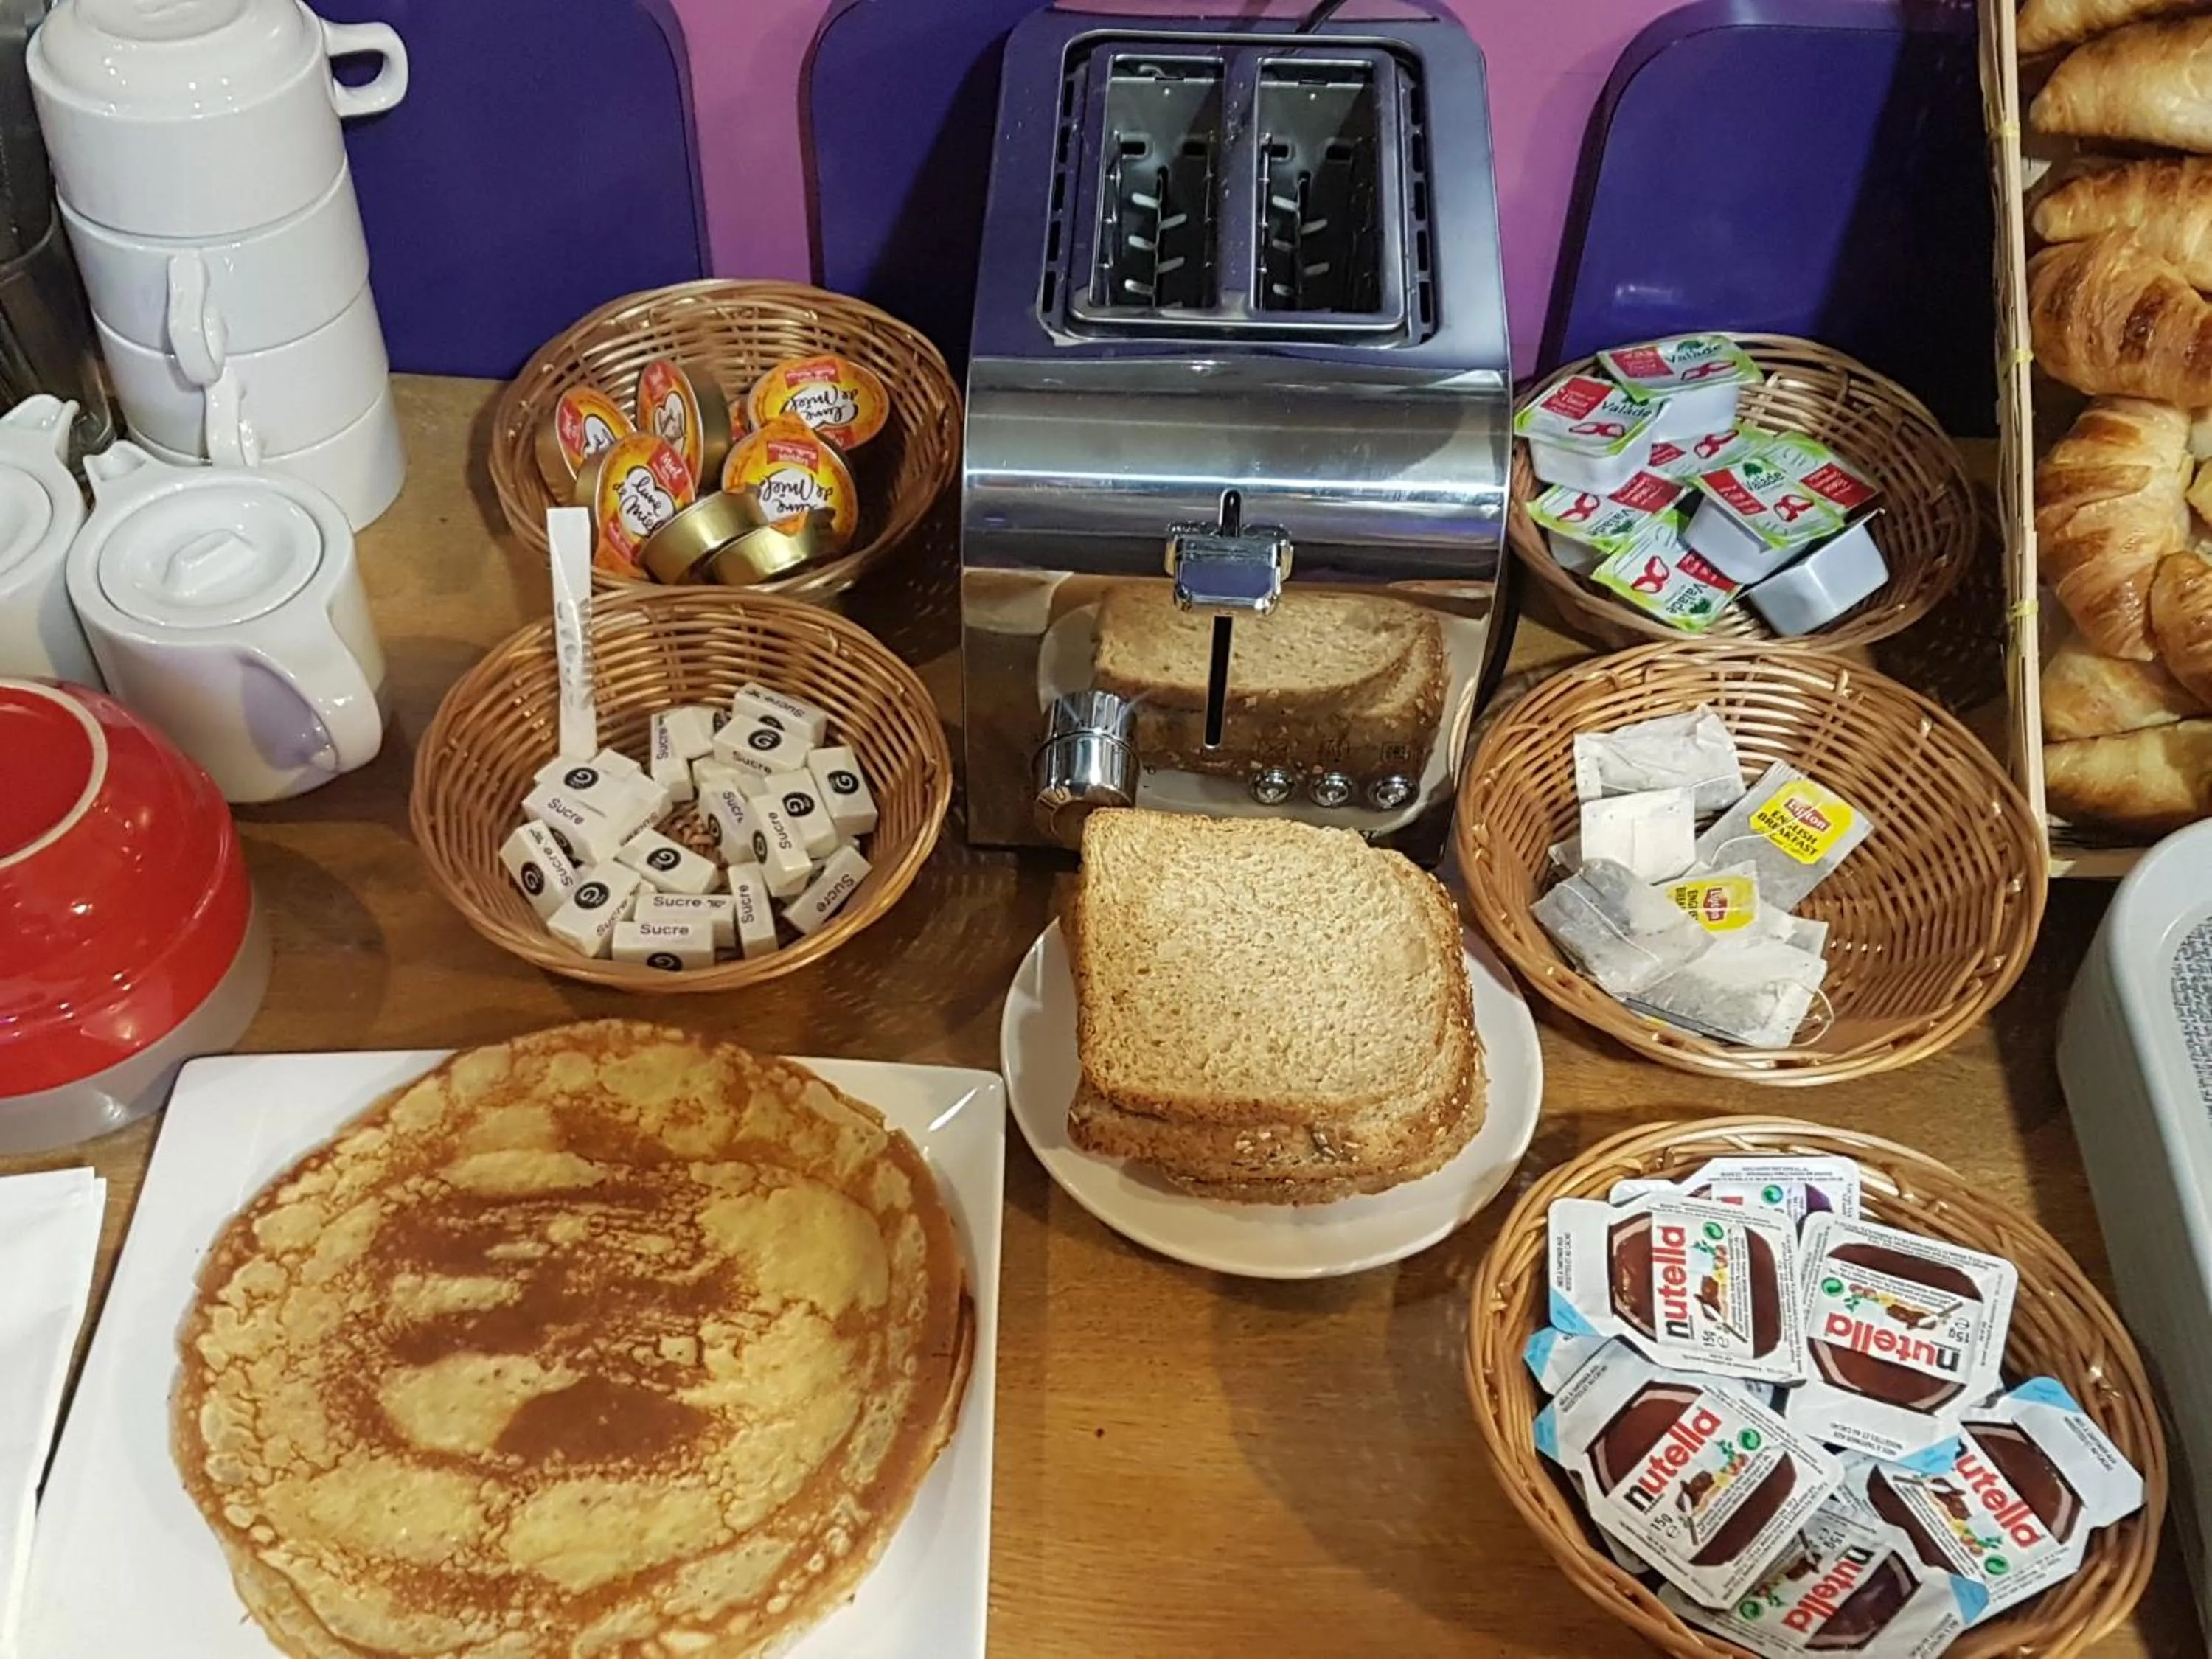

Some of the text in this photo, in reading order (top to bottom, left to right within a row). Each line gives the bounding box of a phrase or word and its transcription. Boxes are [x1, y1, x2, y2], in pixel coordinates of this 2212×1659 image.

[547, 796, 585, 825] Sucre
[768, 812, 793, 850] Sucre
[543, 847, 574, 887] Sucre
[653, 895, 701, 908] Sucre
[737, 884, 755, 924] Sucre
[815, 874, 855, 914] Sucre
[639, 924, 689, 936] Sucre
[1652, 1225, 1690, 1340] nutella
[1824, 1312, 1961, 1373] nutella
[1622, 1407, 1722, 1513] nutella
[1781, 1543, 1877, 1634] nutella
